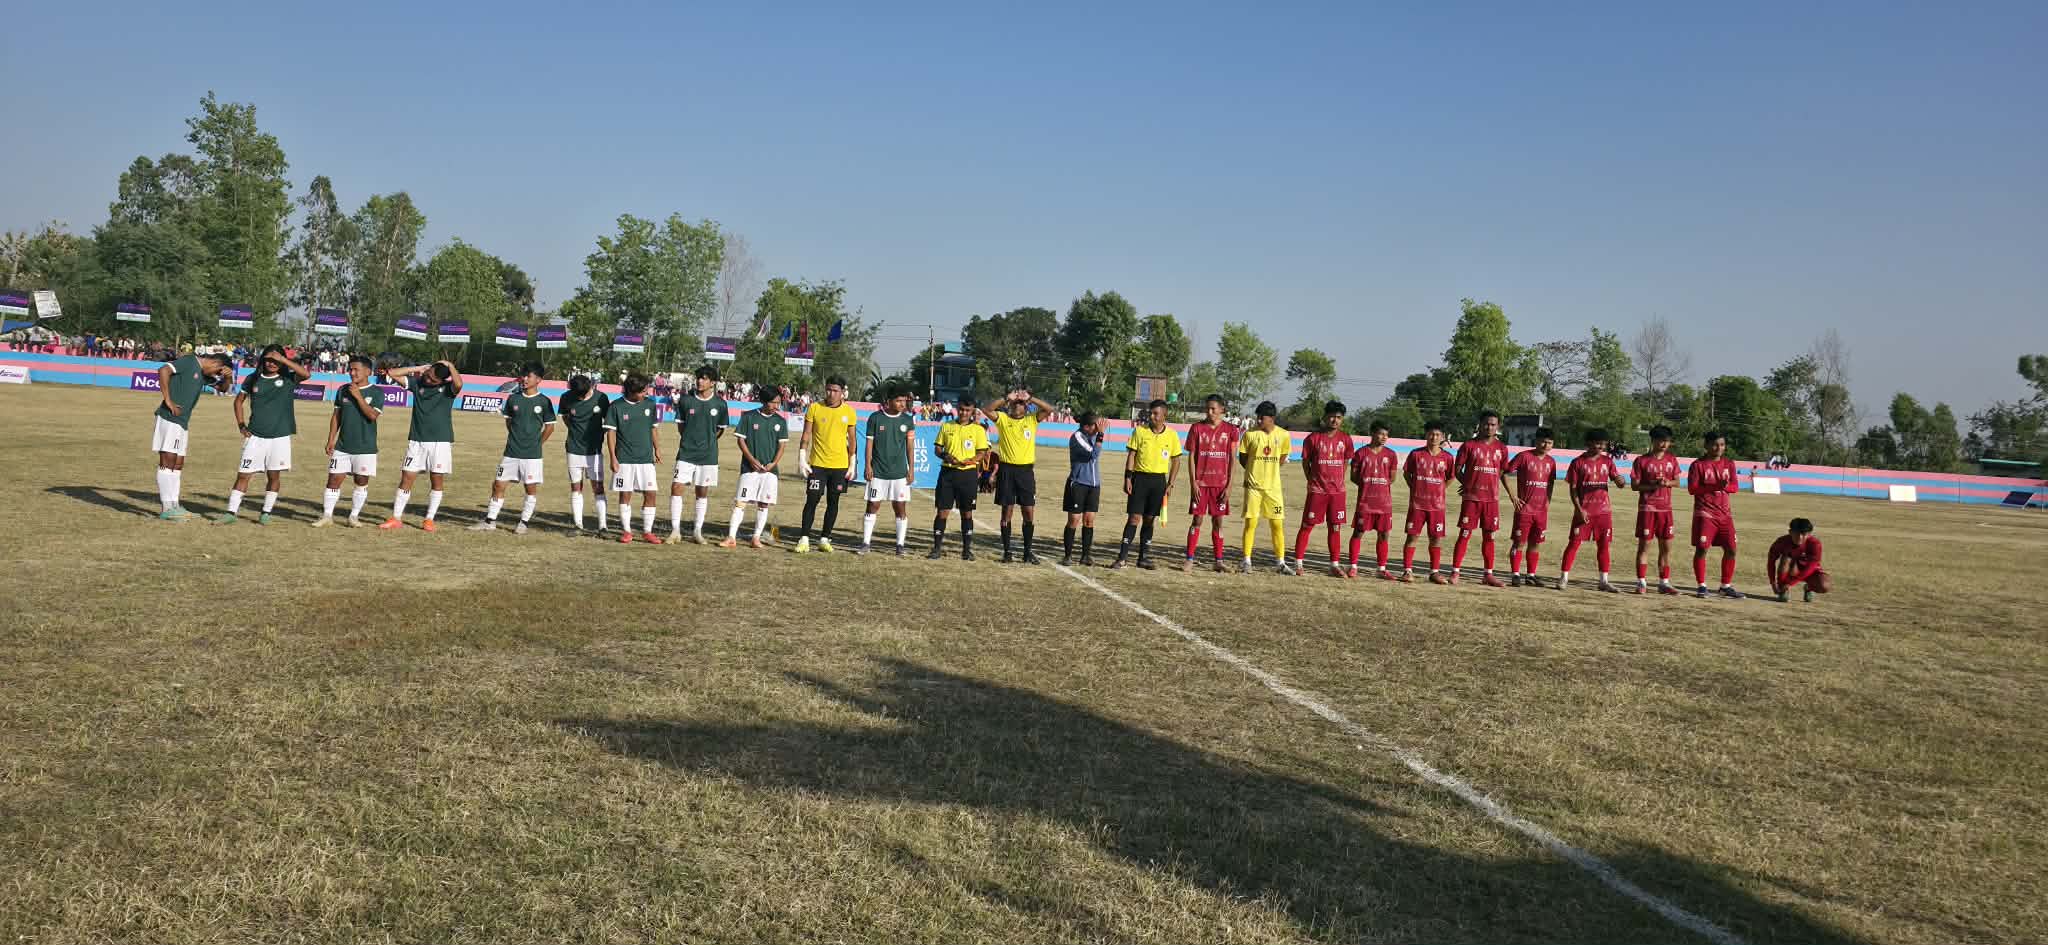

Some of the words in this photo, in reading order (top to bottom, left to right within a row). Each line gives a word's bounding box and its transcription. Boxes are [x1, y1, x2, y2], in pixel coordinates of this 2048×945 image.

[464, 396, 501, 407] XTREME
[242, 459, 252, 469] 12
[329, 459, 338, 470] 21
[404, 456, 414, 467] 17
[616, 477, 624, 488] 19
[809, 479, 820, 490] 25
[741, 487, 748, 498] 8
[1274, 506, 1283, 515] 32
